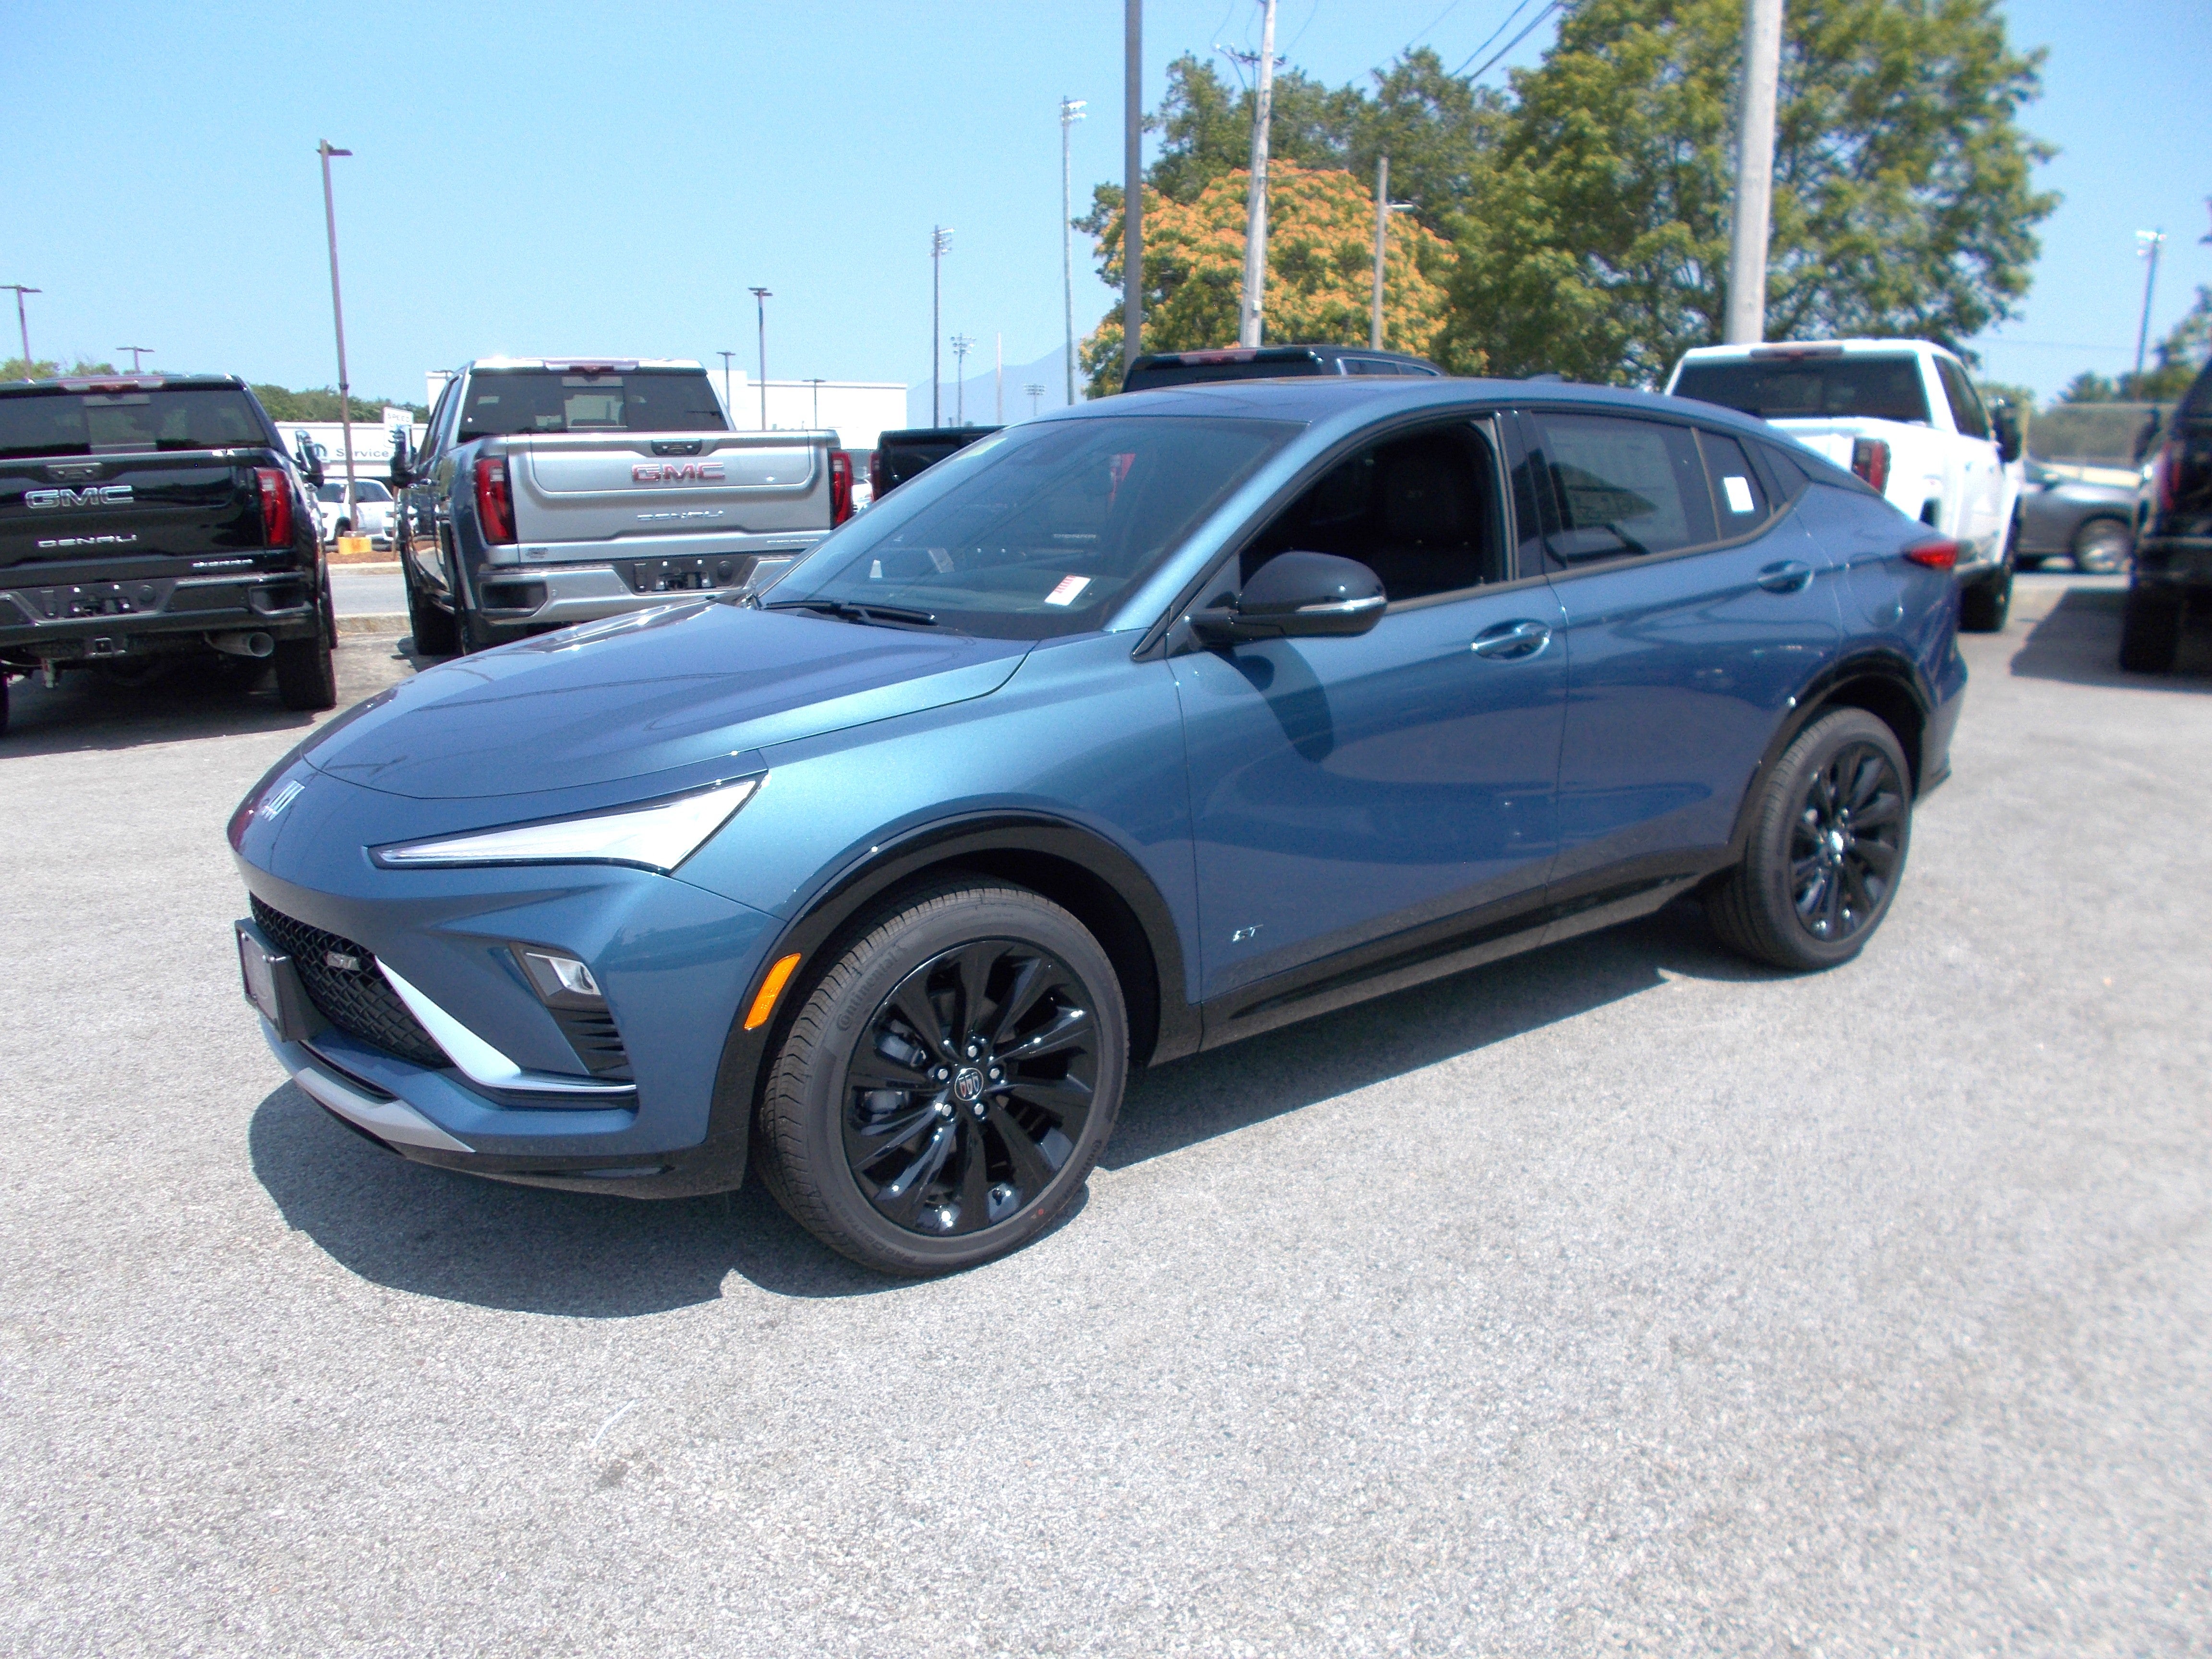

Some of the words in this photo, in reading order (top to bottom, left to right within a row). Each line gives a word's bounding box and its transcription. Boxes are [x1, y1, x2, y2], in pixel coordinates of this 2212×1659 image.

[387, 413, 410, 422] SPEED
[336, 448, 389, 457] Srvice
[632, 462, 725, 481] GMC
[25, 485, 133, 508] GMC
